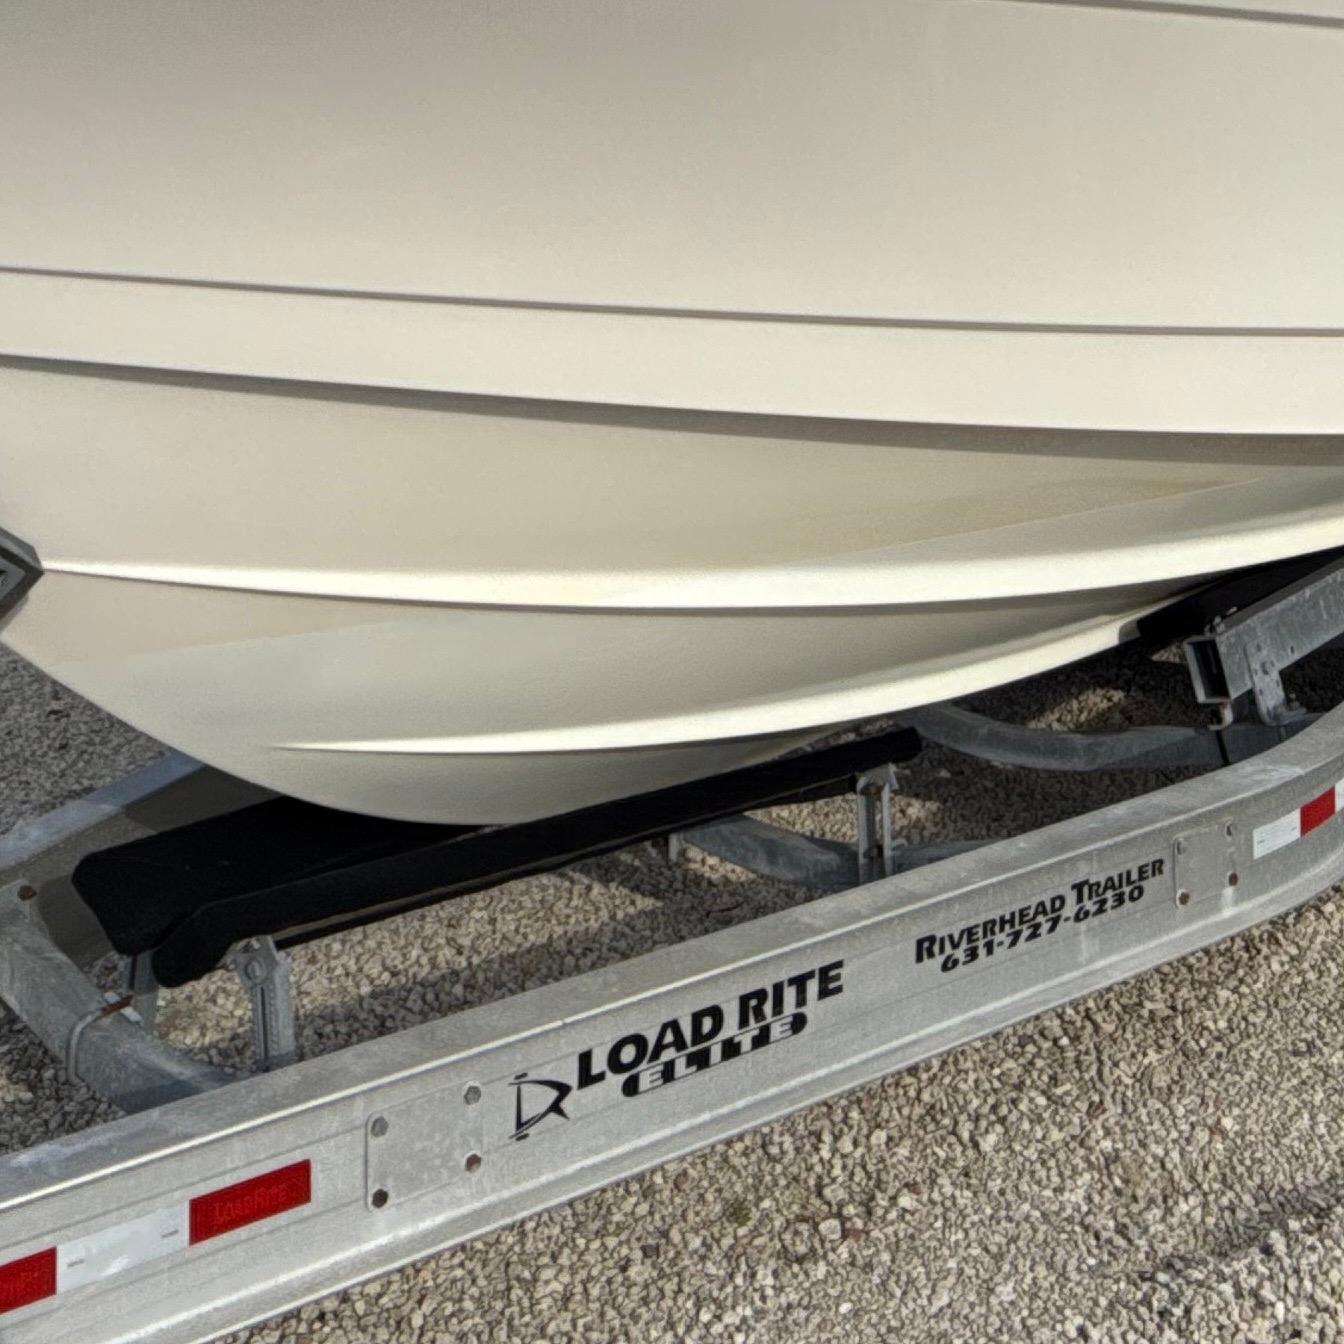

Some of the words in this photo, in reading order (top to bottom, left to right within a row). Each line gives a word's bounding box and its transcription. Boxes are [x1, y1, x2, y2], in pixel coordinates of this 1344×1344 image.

[940, 884, 1144, 973] 631-727-6230
[576, 1004, 725, 1090] LOAD
[738, 959, 844, 1030] RITE
[637, 1014, 794, 1096] ELITE
